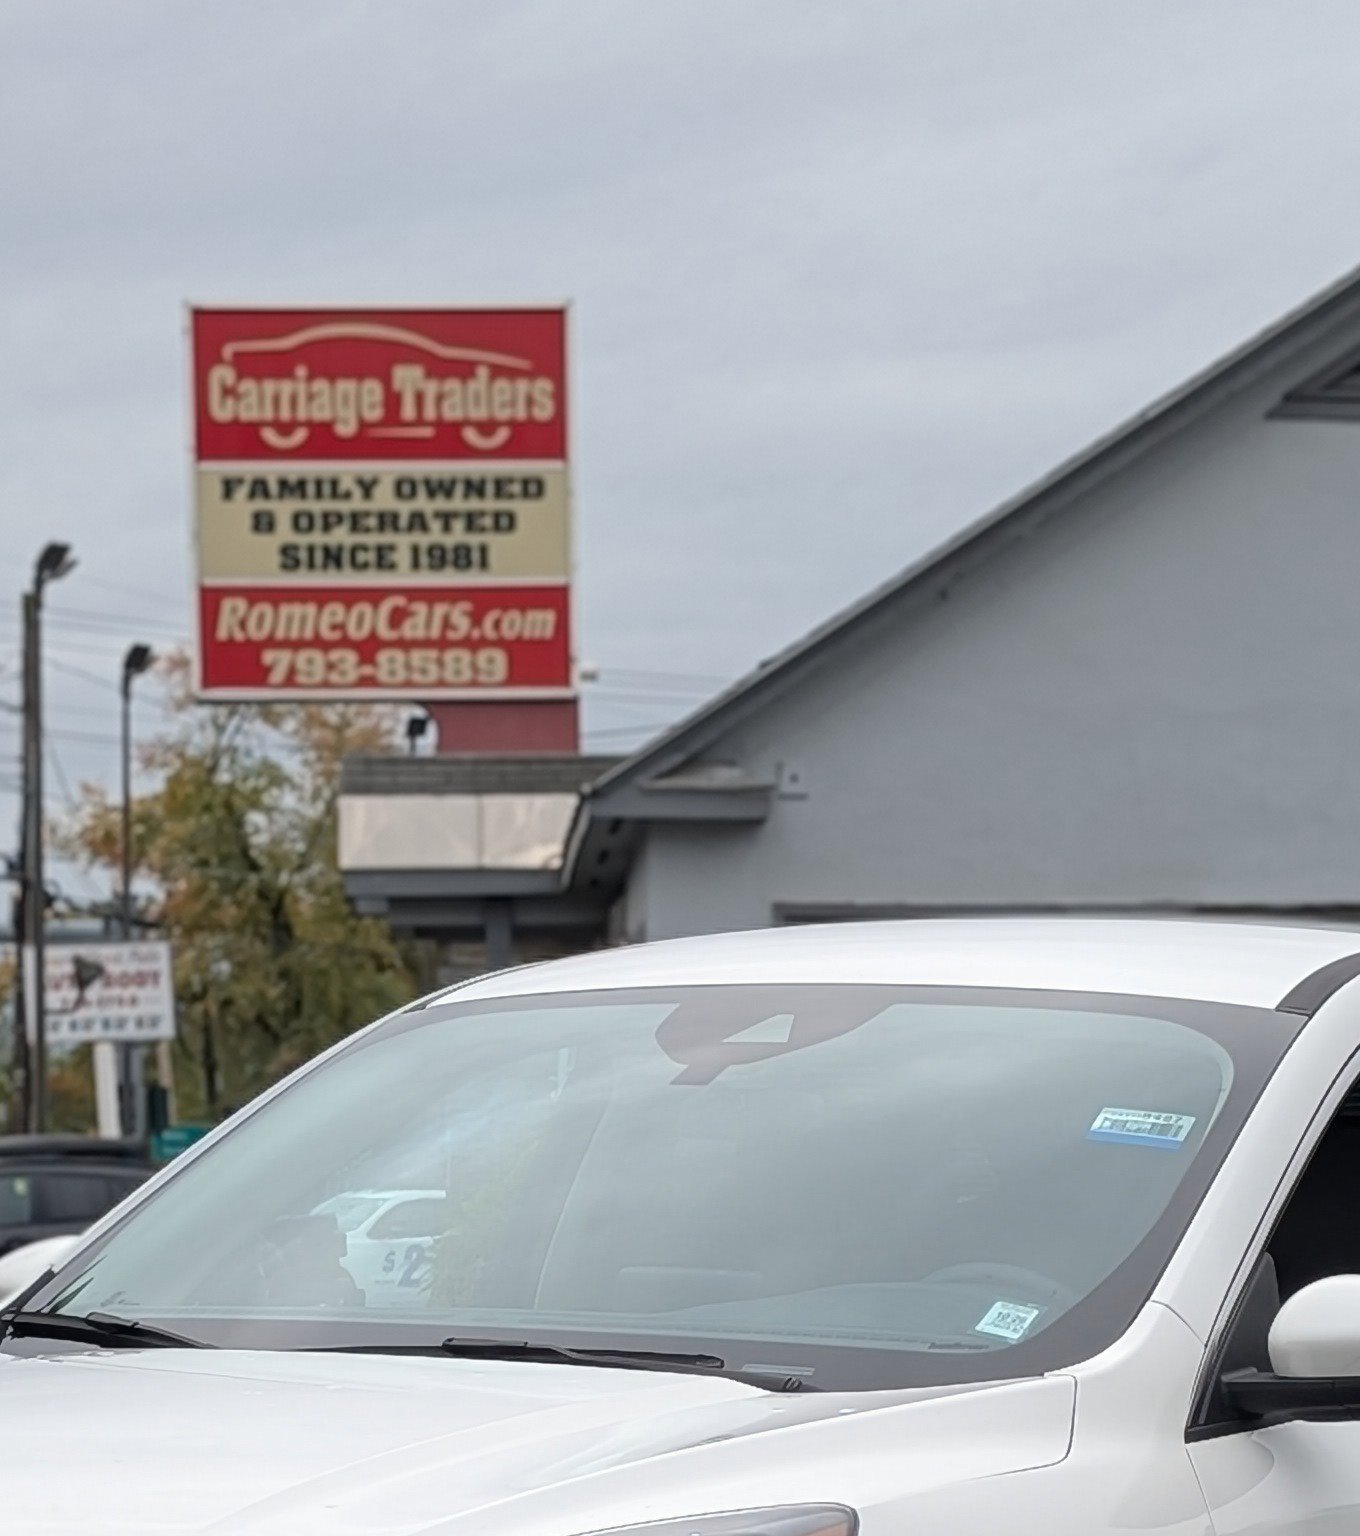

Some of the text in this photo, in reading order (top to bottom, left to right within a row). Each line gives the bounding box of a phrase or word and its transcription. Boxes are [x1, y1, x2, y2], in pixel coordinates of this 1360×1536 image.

[207, 362, 556, 440] Carriage Traders
[221, 476, 546, 501] FAMILY OWNED
[291, 509, 517, 535] OPERATED
[279, 542, 490, 573] SINCE 1981
[215, 595, 557, 642] RomeoCars.com
[260, 647, 509, 686] 793-8589
